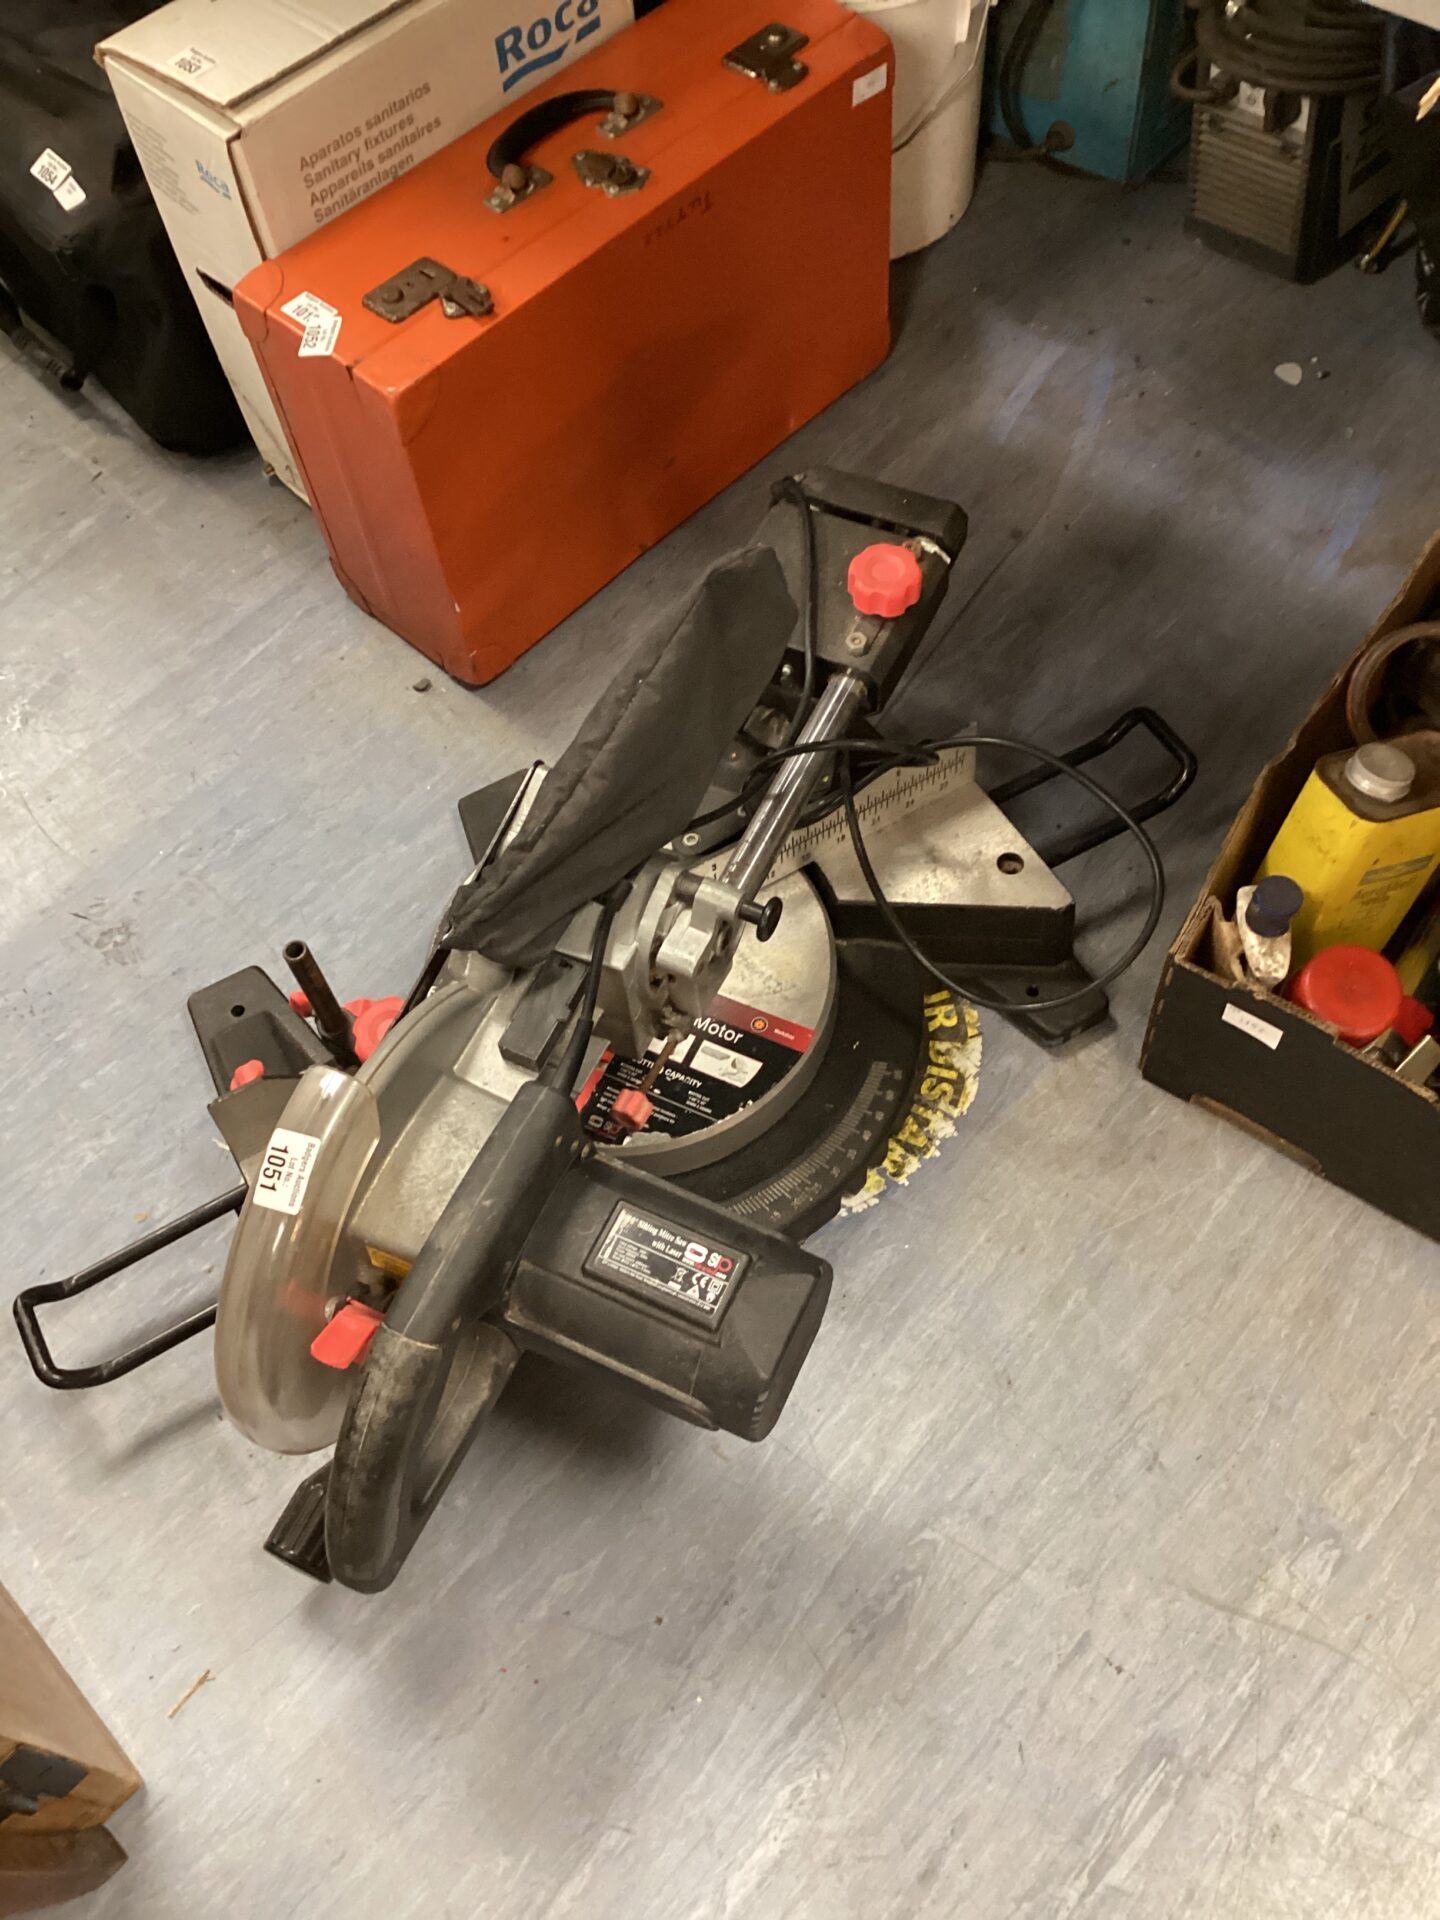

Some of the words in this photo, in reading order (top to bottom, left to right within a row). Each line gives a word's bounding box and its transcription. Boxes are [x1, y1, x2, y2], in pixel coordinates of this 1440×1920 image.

[495, 0, 598, 73] Roca
[300, 125, 362, 172] Aparatos
[365, 82, 431, 131] sanitarios
[303, 147, 361, 189] Sanitary
[364, 113, 415, 151] fixtures
[310, 158, 375, 207] Appareils
[378, 116, 442, 164] sanitaires
[313, 153, 415, 223] Sanitäranlagen
[303, 325, 321, 348] 1052
[693, 1017, 743, 1044] Motor
[664, 1067, 703, 1089] CAPACITY
[260, 1145, 289, 1192] 1051
[288, 1157, 299, 1170] Lot
[651, 1239, 666, 1253] with
